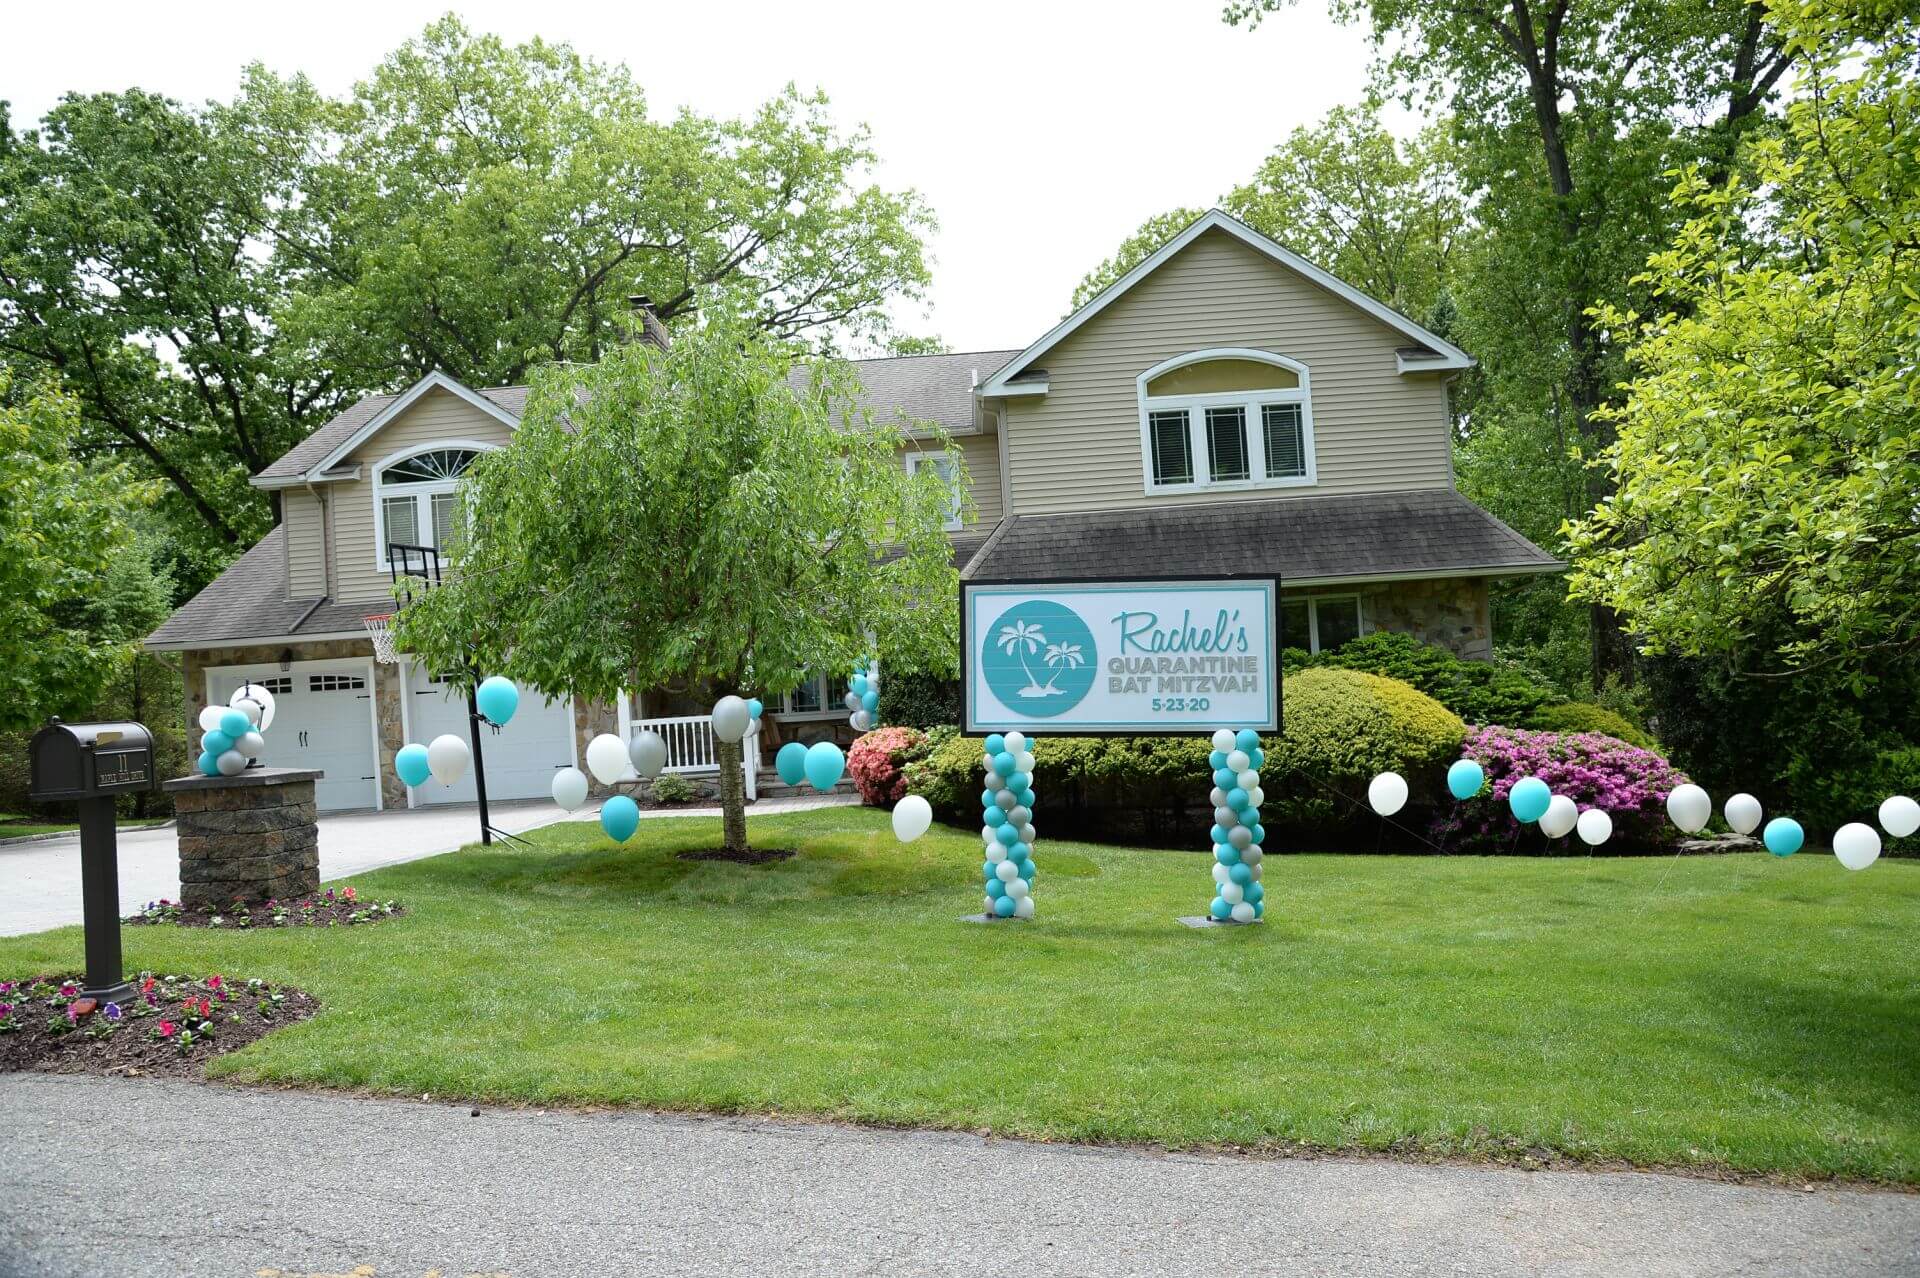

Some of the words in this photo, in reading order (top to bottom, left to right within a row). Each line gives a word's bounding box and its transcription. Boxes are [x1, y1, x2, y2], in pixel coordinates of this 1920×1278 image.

[1111, 609, 1248, 654] Rachel's
[1107, 655, 1258, 674] QUARANTINE
[1108, 676, 1151, 693] BAT
[1157, 675, 1258, 693] MITZVAH
